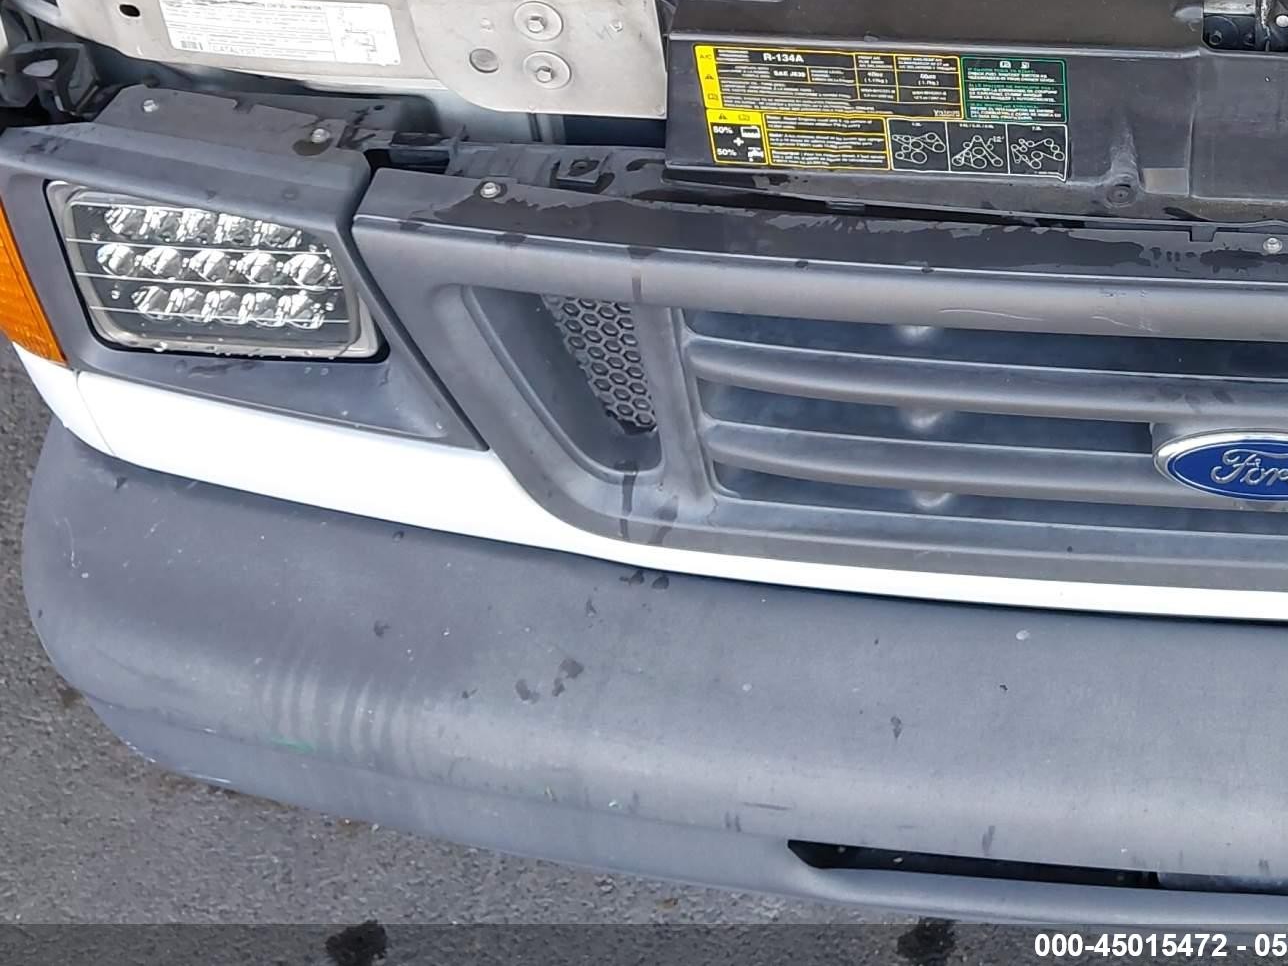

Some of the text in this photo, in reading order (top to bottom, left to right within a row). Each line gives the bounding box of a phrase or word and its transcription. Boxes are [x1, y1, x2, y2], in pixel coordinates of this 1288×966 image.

[763, 52, 805, 64] R-134A
[713, 125, 733, 135] 50%
[717, 147, 737, 157] 50%
